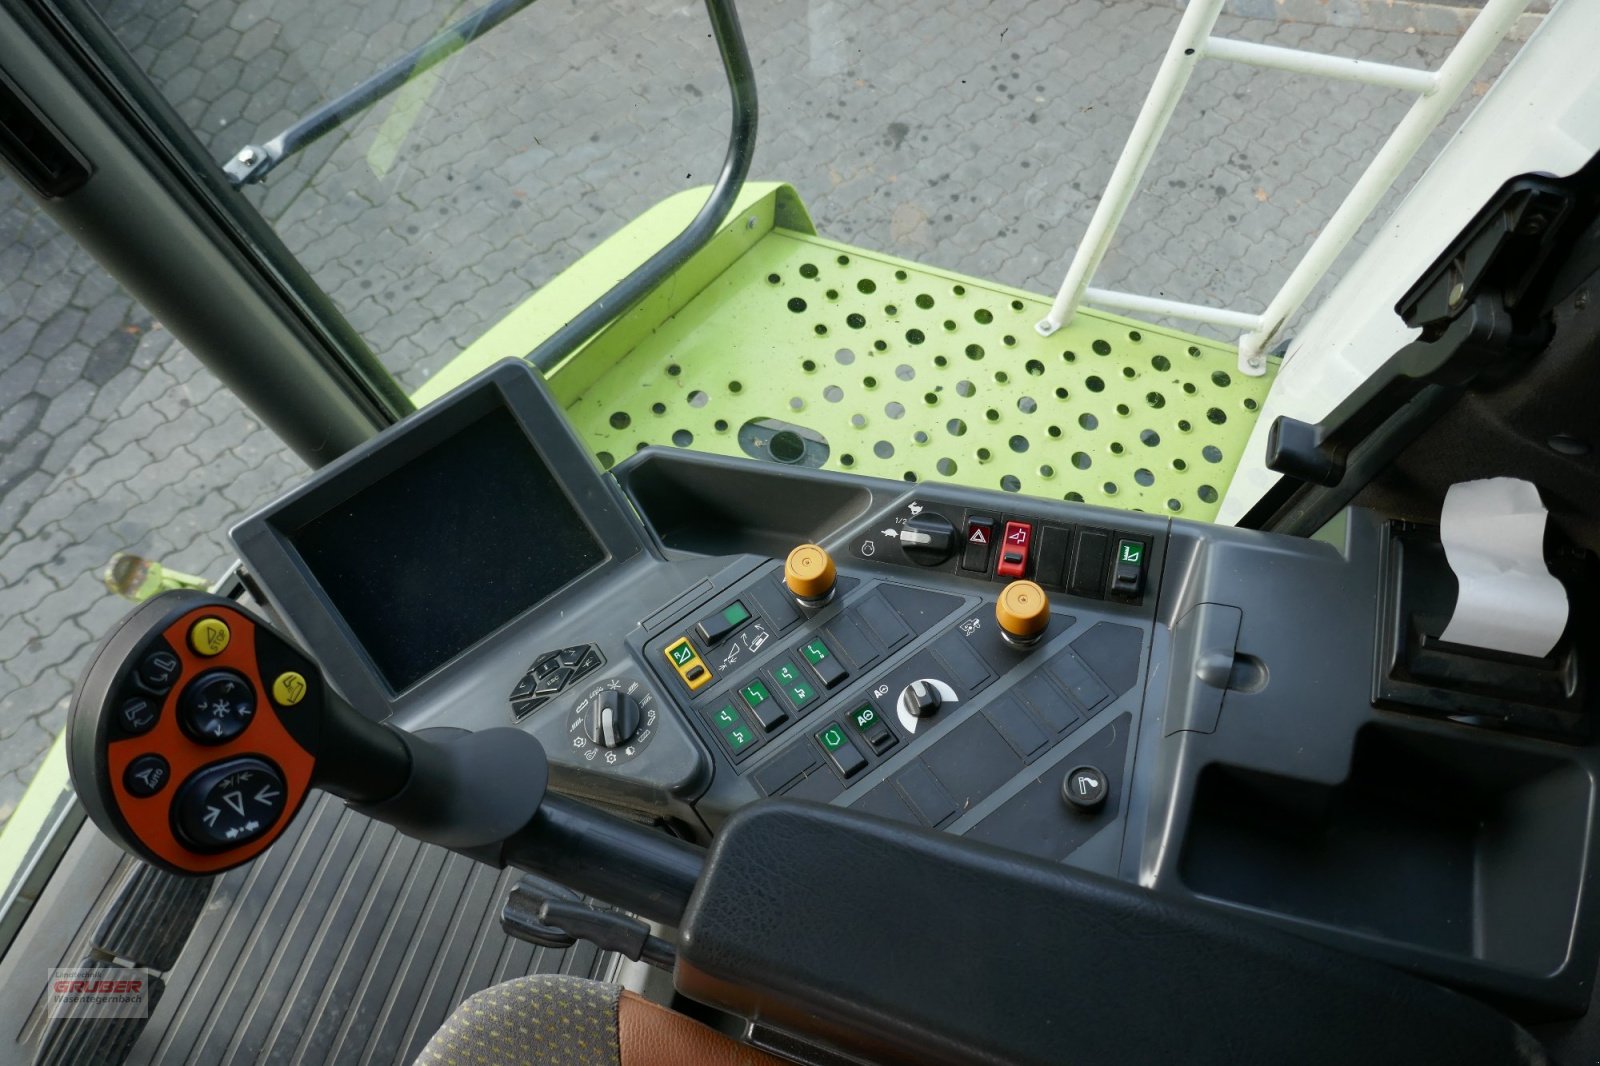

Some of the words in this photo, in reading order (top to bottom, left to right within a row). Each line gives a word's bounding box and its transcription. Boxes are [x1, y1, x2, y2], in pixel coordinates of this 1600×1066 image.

[210, 629, 225, 652] STOP
[673, 651, 682, 660] R
[546, 675, 560, 686] ESC
[149, 768, 164, 789] AUTO
